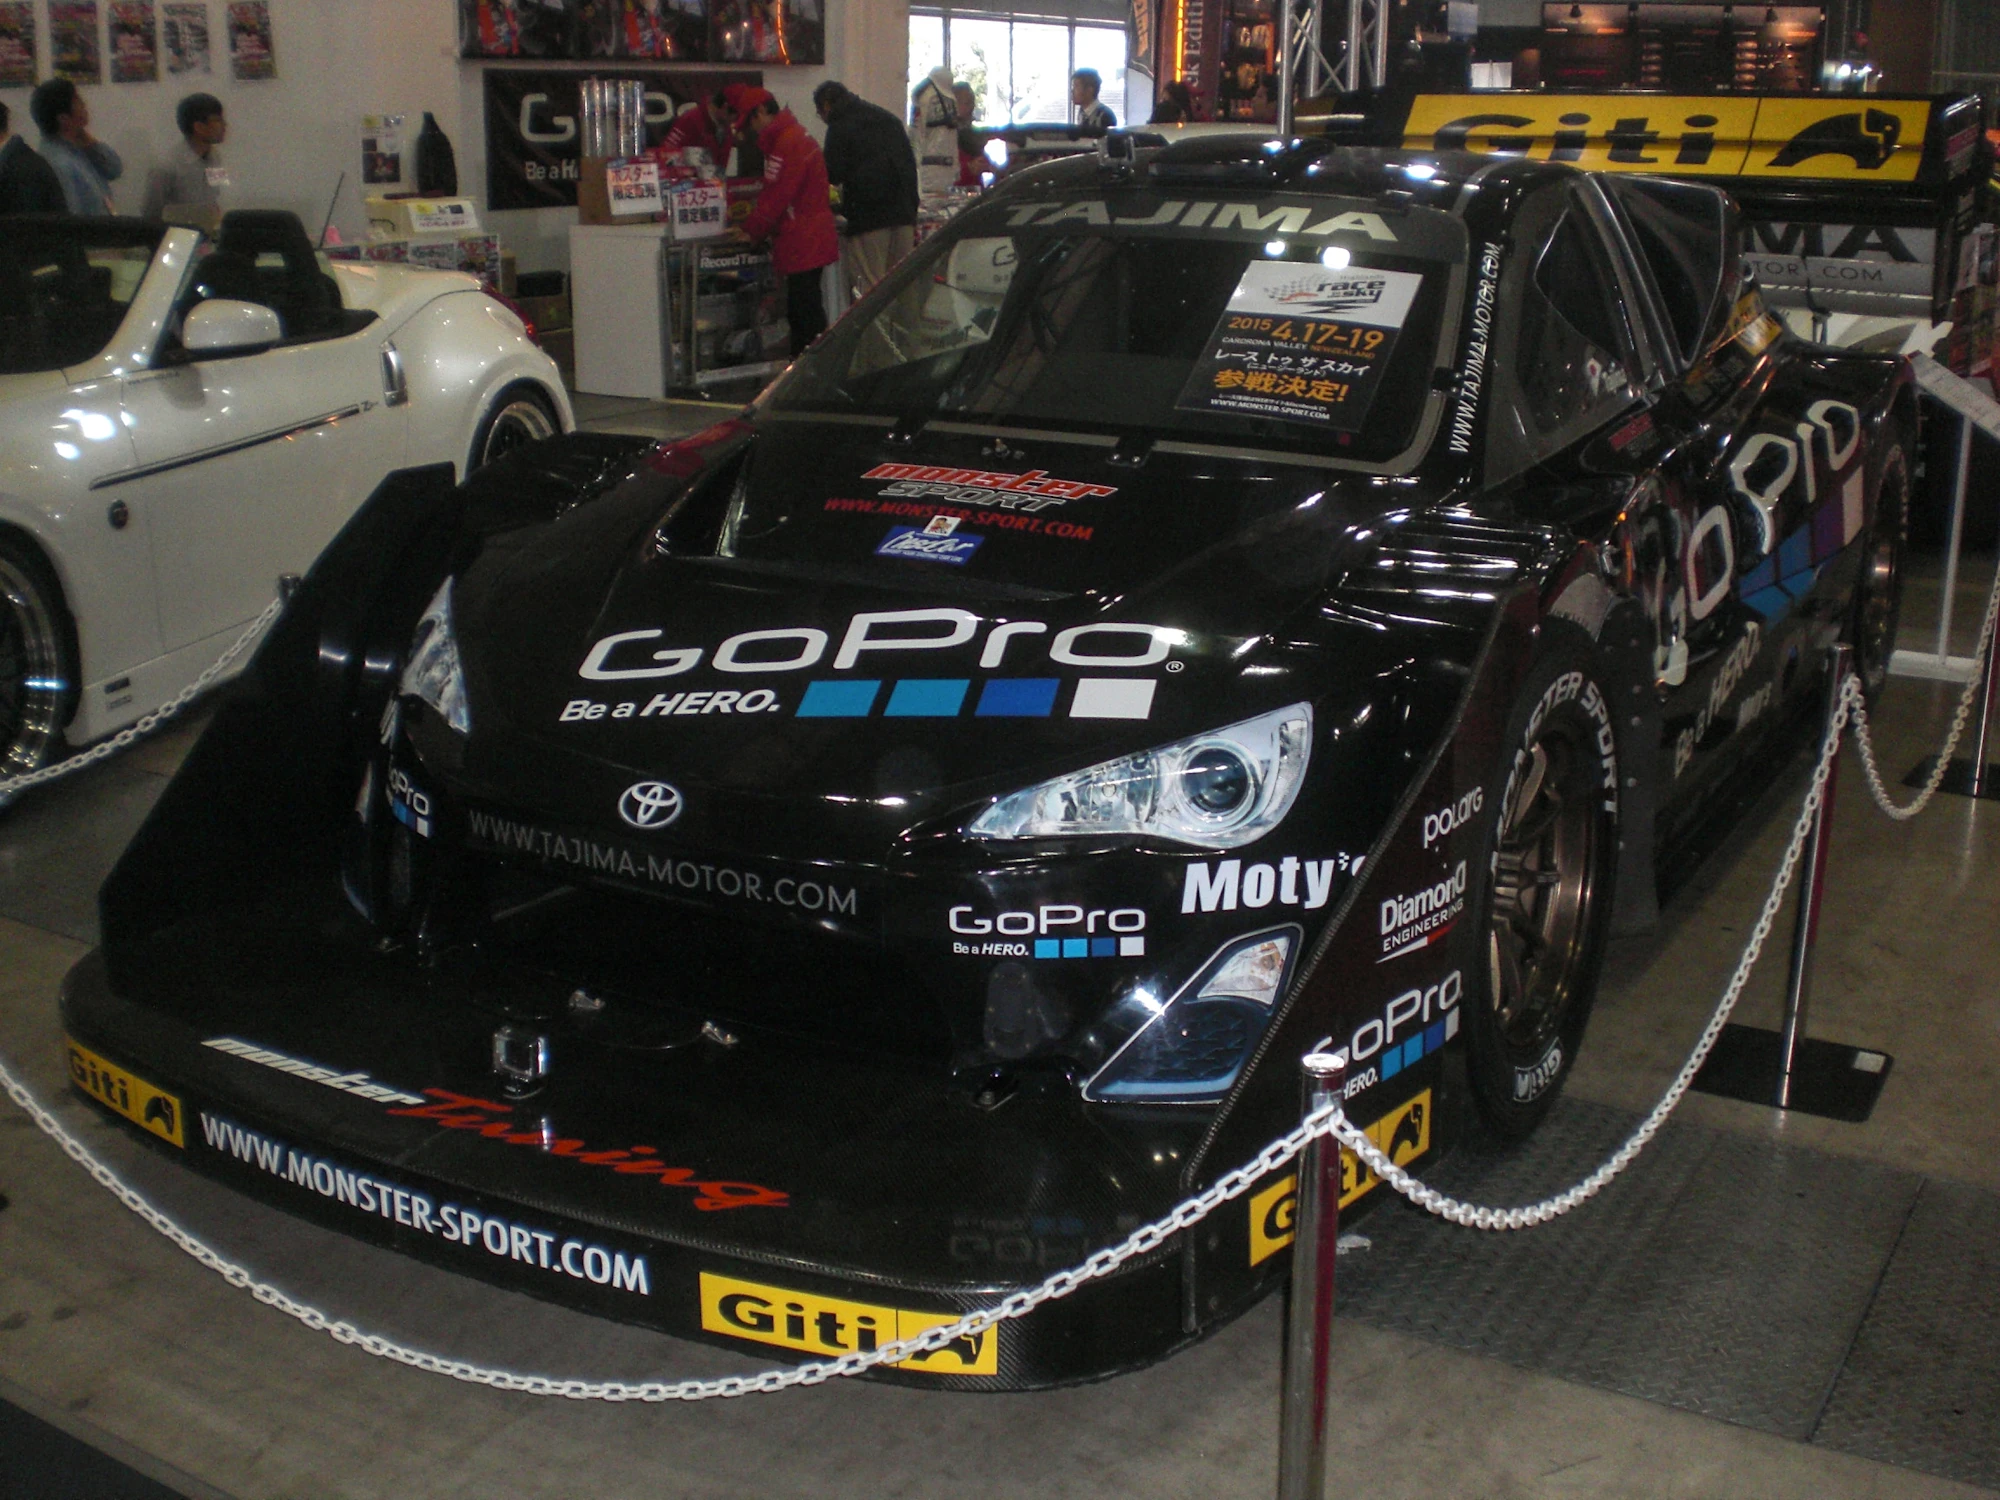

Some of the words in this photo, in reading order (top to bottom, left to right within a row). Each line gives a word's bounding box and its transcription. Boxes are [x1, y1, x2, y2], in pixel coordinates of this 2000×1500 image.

[1433, 112, 1721, 166] Giti
[1006, 201, 1398, 242] TAJIMA
[1317, 281, 1386, 292] race
[1344, 288, 1382, 303] sky
[1228, 317, 1273, 331] 2015
[1272, 320, 1385, 350] 4.17-19
[1449, 242, 1500, 453] WWW.TAJIMA-MOTOR.COM
[1213, 369, 1349, 402] 参戦決定!
[861, 463, 1118, 499] monster
[878, 481, 1066, 512] SPORT
[824, 498, 1094, 541] WWW.MONSTER-SPORT.COM
[578, 608, 1172, 680] GoPro
[559, 699, 602, 722] Be
[603, 702, 635, 718] a
[641, 689, 779, 716] HERO.
[388, 768, 430, 816] oPro
[469, 810, 857, 915] WWW.TAJIMA-MOTOR.COM
[949, 905, 1145, 935] GoPro
[1381, 860, 1467, 936] Diamond
[1383, 898, 1464, 953] ENGINEERING
[953, 943, 970, 954] Be
[971, 945, 979, 954] a
[980, 943, 1029, 956] HERO.
[69, 1053, 129, 1111] Giti
[201, 1037, 425, 1105] monster
[201, 1111, 650, 1296] WWW.MONSTER-SPORT.COM
[718, 1293, 877, 1358] Giti
